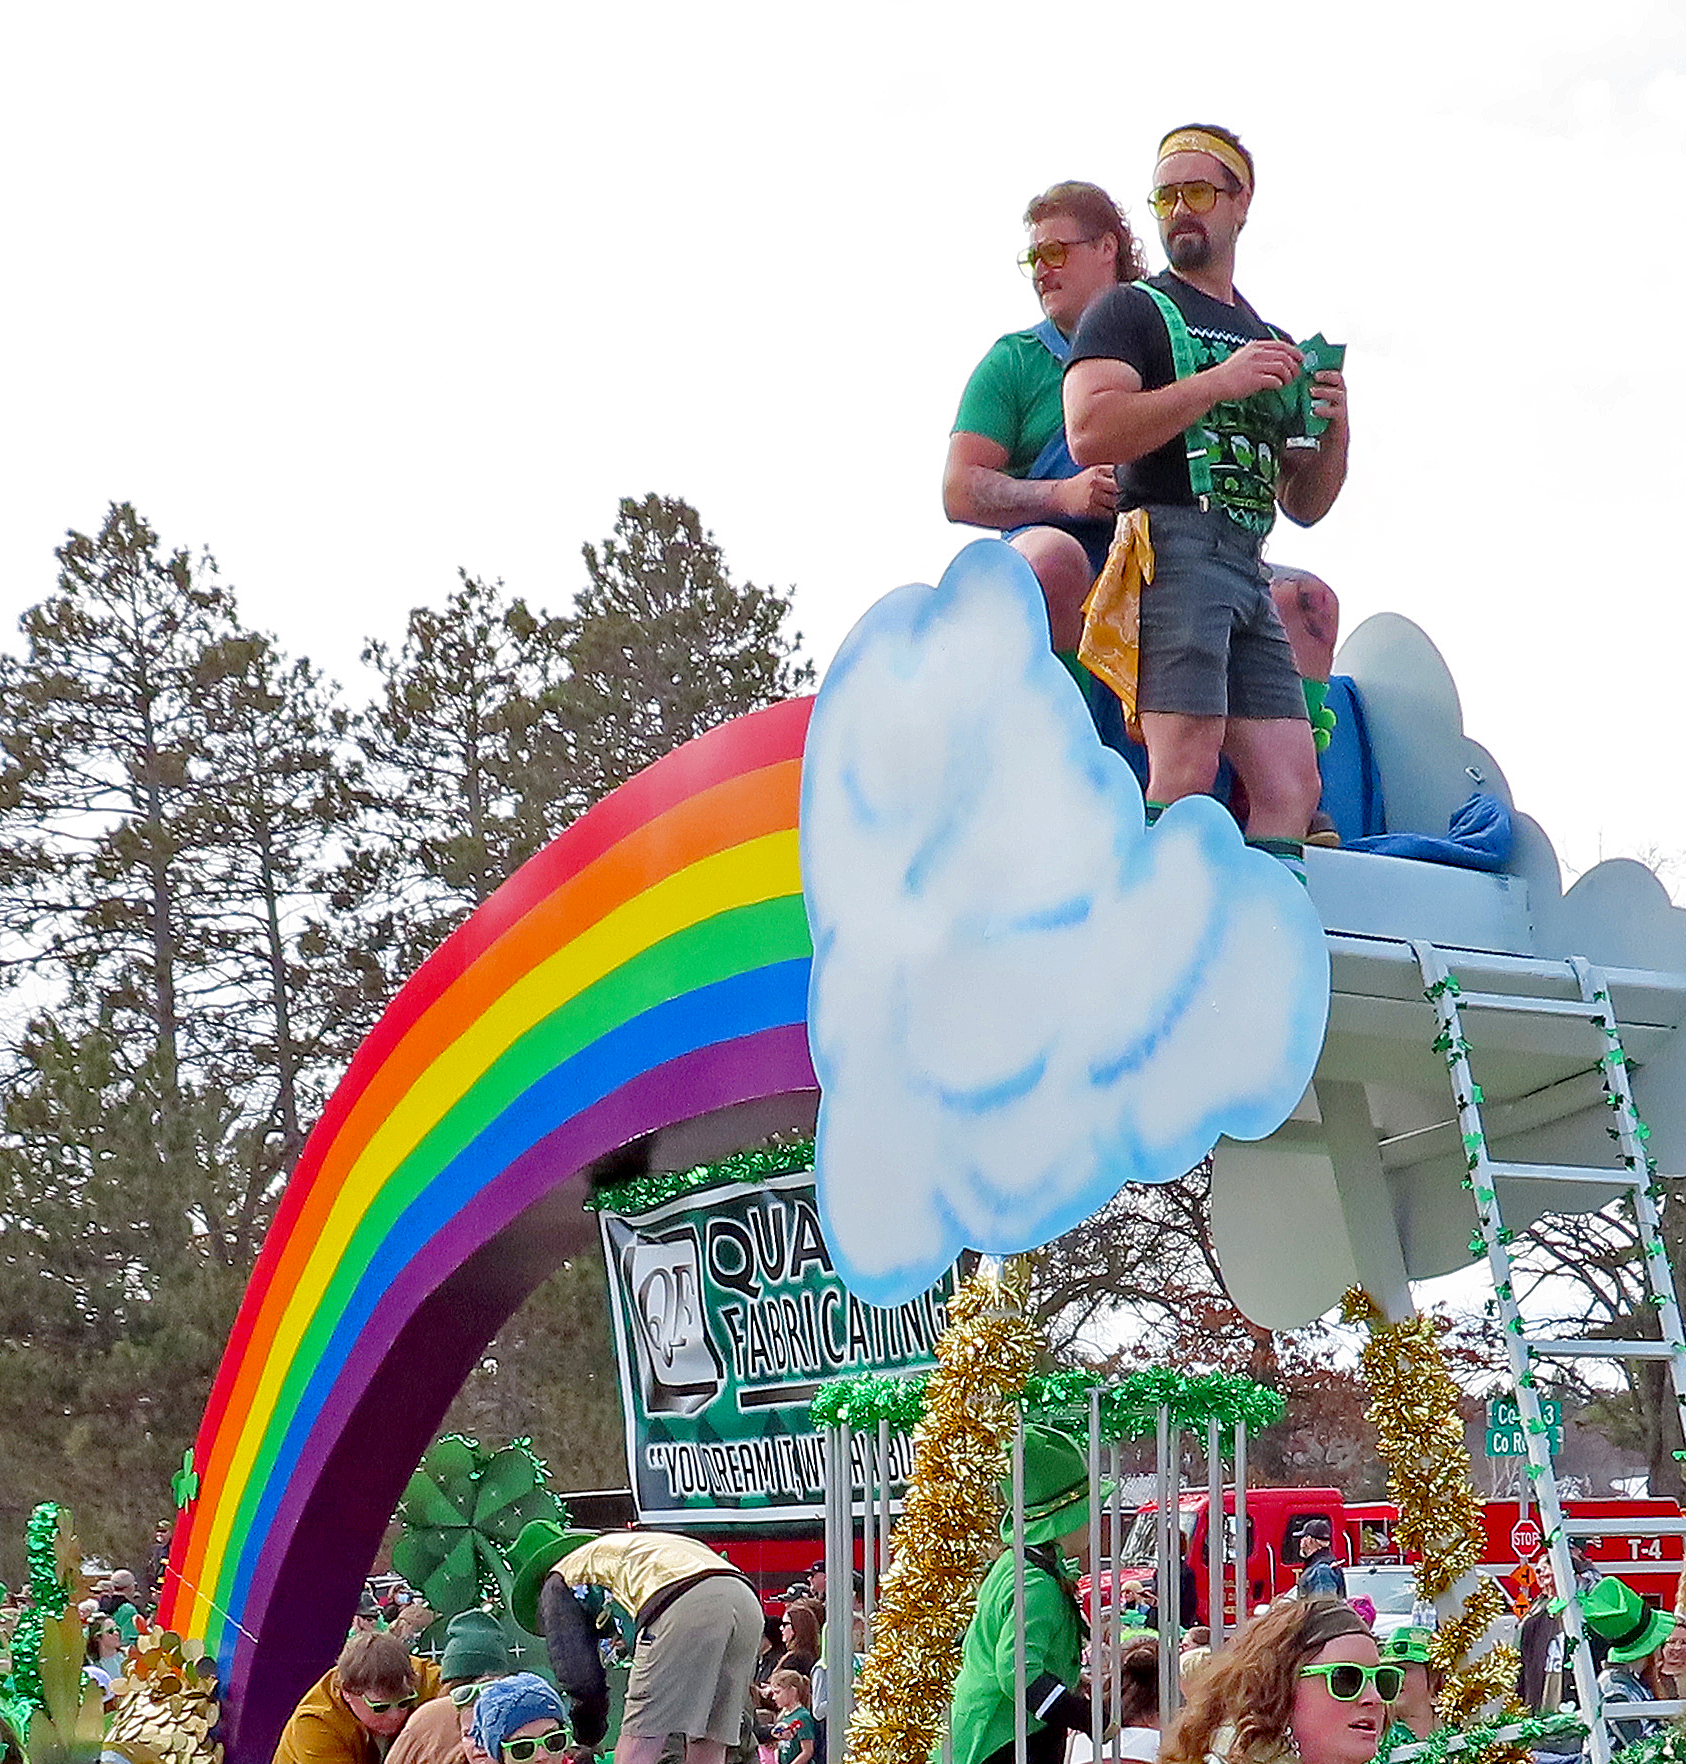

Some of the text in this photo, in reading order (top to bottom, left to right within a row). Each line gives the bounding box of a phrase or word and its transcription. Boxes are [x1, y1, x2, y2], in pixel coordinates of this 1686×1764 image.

[708, 1204, 833, 1298] QUA
[1493, 1433, 1510, 1454] Co
[704, 1441, 776, 1493] DREAM
[1515, 1531, 1538, 1546] STOP
[1628, 1538, 1663, 1560] T-4
